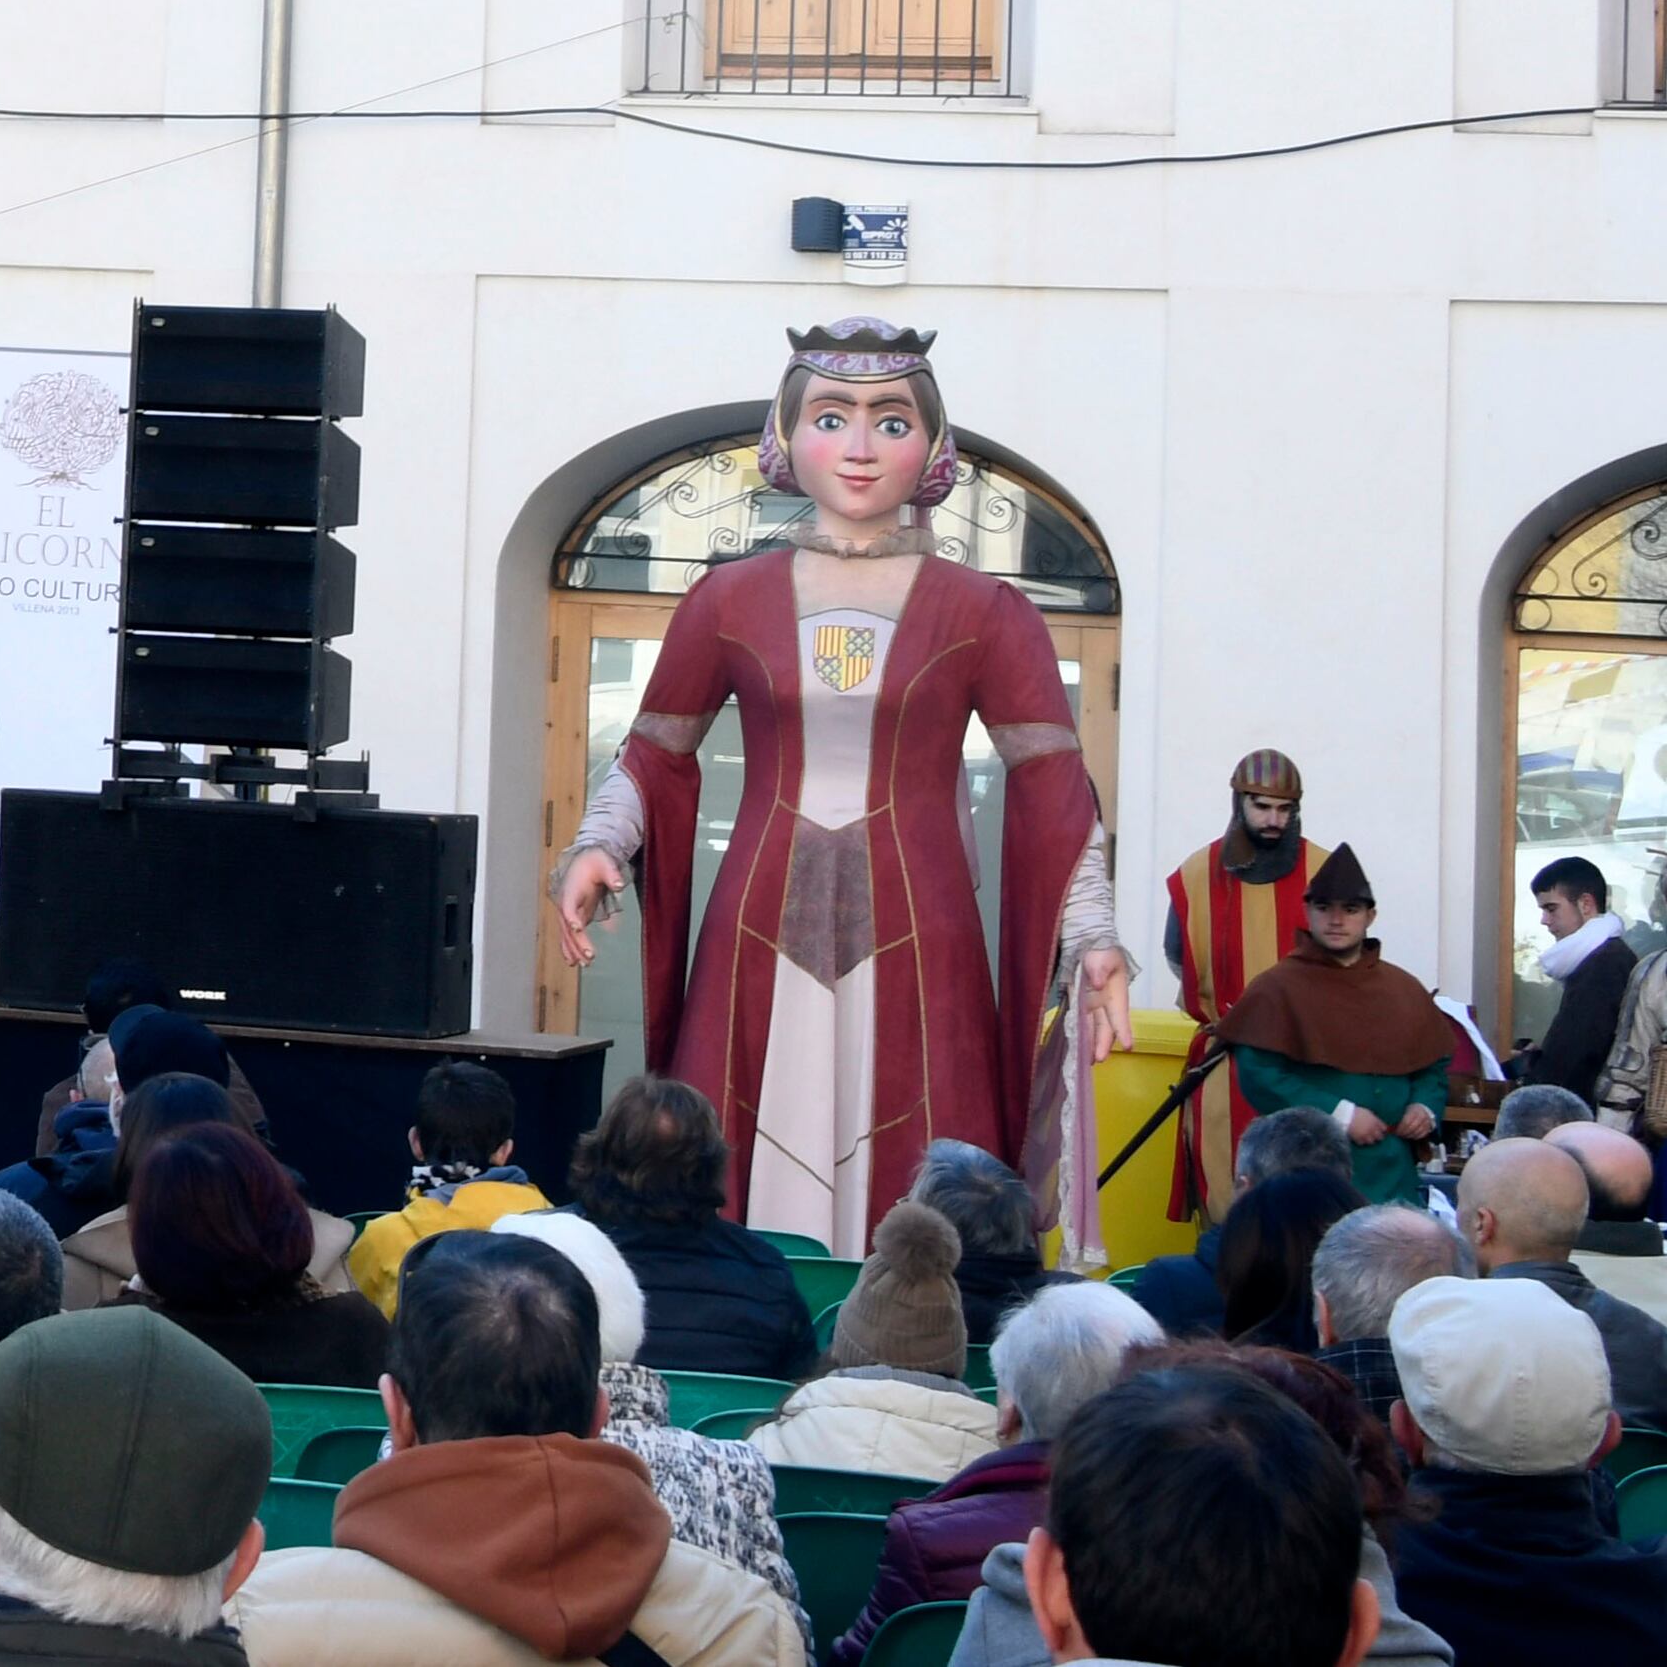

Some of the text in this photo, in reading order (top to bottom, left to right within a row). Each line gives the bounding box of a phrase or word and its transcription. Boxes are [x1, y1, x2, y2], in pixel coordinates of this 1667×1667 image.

[37, 494, 75, 529] EL
[23, 578, 121, 604] CULTUR
[12, 603, 80, 616] VILLENA 2013
[179, 989, 226, 1000] WORK
